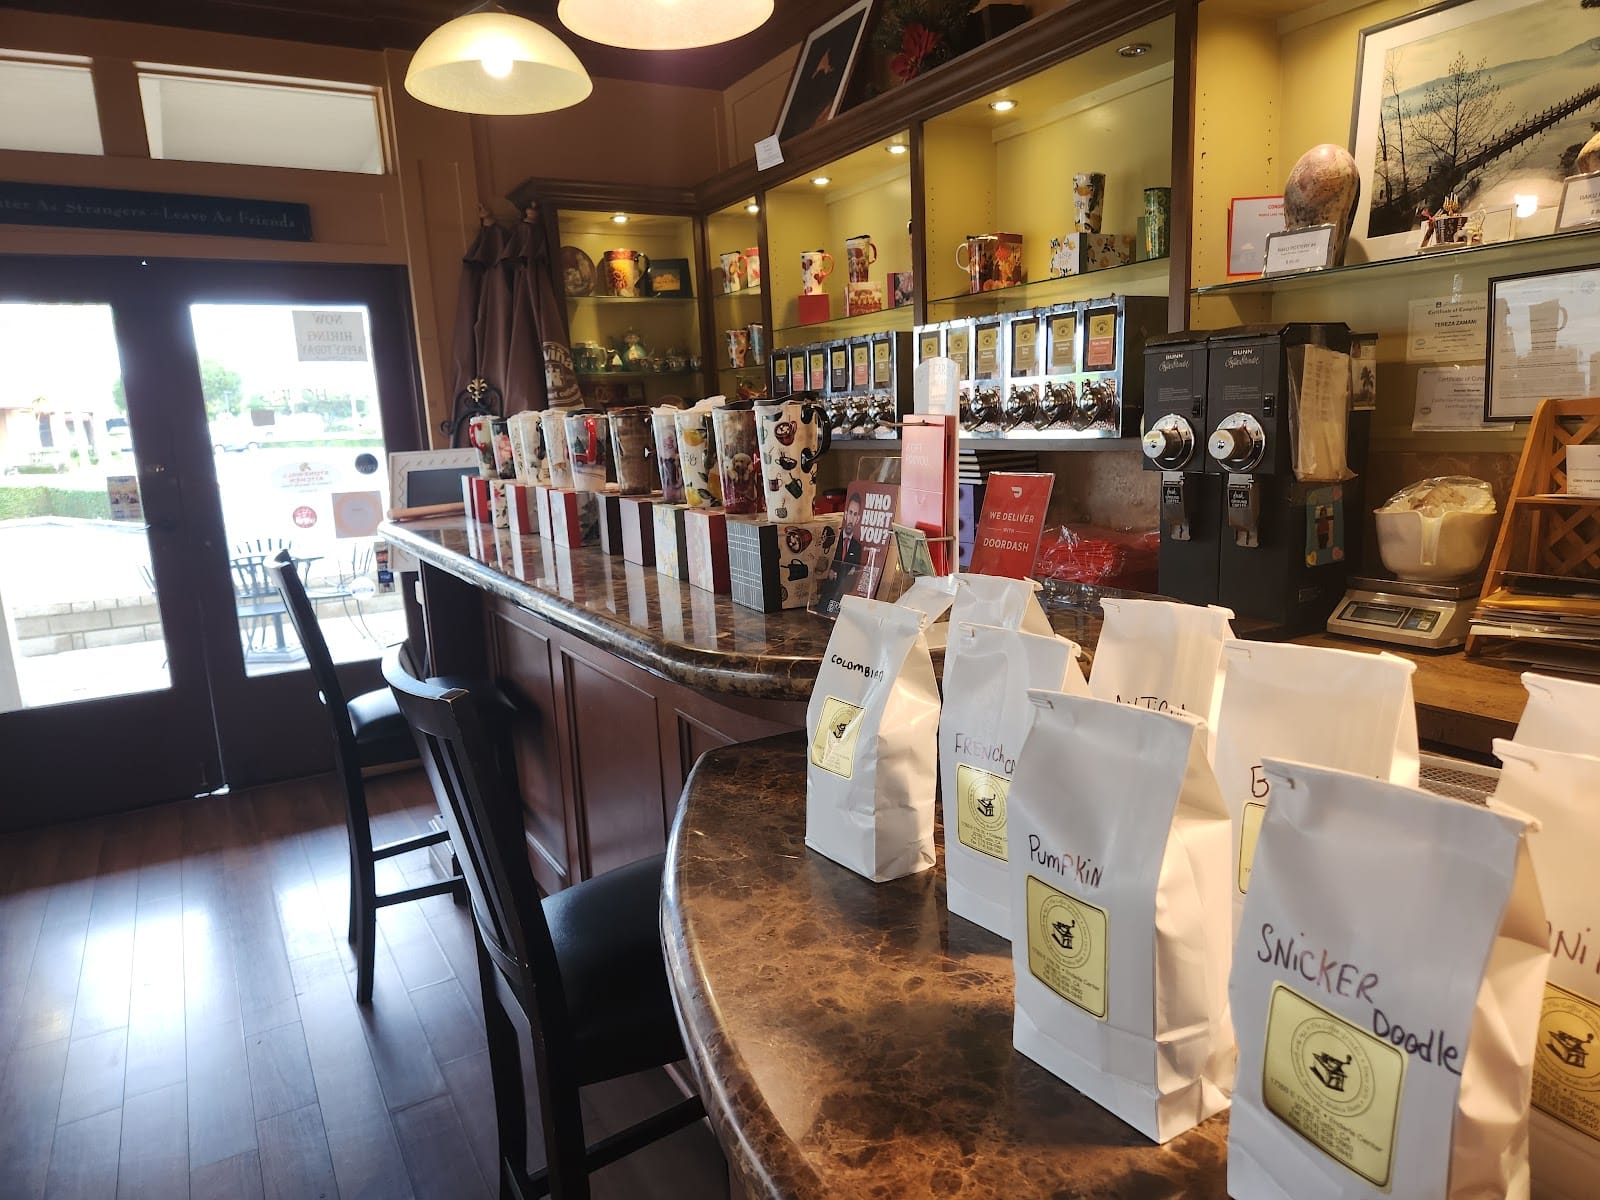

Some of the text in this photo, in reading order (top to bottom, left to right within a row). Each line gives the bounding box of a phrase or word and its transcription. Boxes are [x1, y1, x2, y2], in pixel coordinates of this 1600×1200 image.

[63, 200, 147, 218] Strangers
[162, 207, 208, 222] Leave
[212, 210, 233, 224] As
[239, 211, 296, 229] Friends
[1165, 353, 1184, 361] BUNN
[1232, 348, 1253, 356] BUNN
[865, 492, 892, 510] WHO
[861, 509, 893, 529] HURT
[989, 511, 1035, 524] WE DELIVER
[859, 529, 890, 545] YOU?
[983, 537, 1029, 553] DOORDASH
